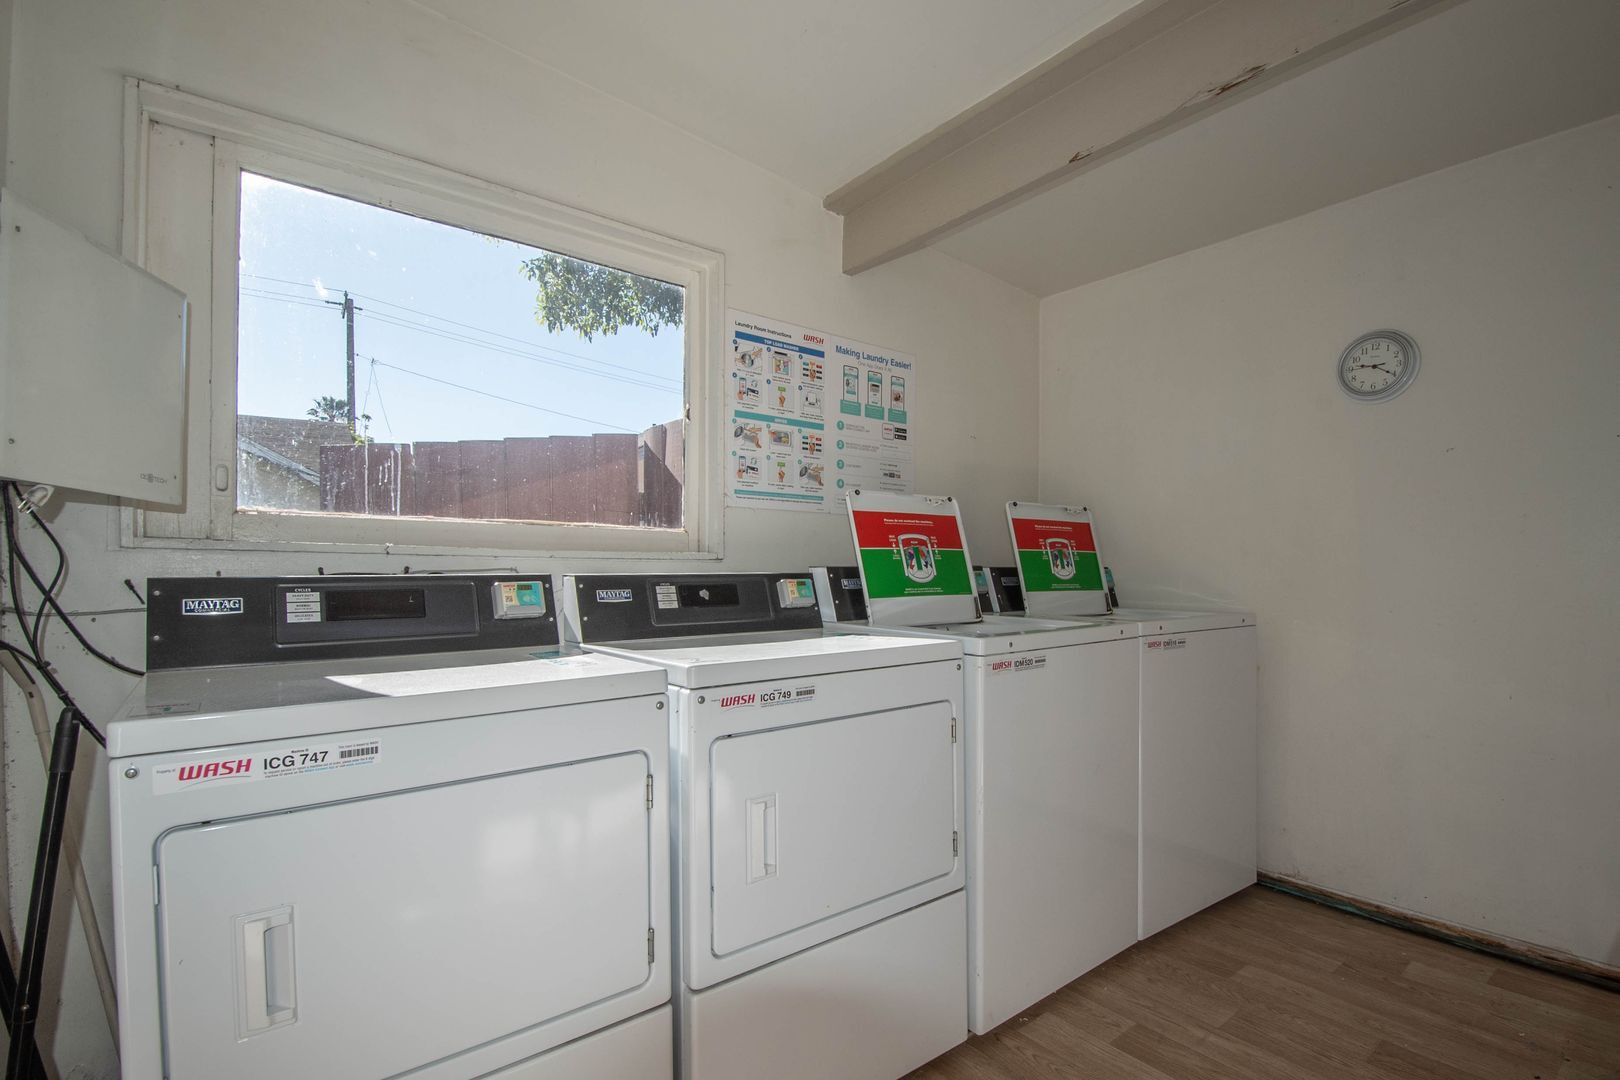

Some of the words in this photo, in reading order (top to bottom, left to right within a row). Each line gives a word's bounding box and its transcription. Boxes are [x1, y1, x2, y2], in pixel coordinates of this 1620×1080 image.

[804, 334, 825, 344] WASH
[835, 345, 860, 360] Making
[862, 352, 889, 366] Laundry
[890, 358, 912, 370] Easier!
[1352, 356, 1361, 364] 10
[1360, 381, 1366, 389] 7
[1382, 378, 1388, 386] 5
[186, 600, 240, 609] MAYTAG
[992, 660, 1012, 670] WASH
[720, 694, 756, 707] WASH
[760, 692, 776, 702] ICG
[777, 690, 791, 700] 749
[264, 755, 295, 770] ICG
[299, 750, 328, 765] 747
[179, 758, 252, 781] WASH
